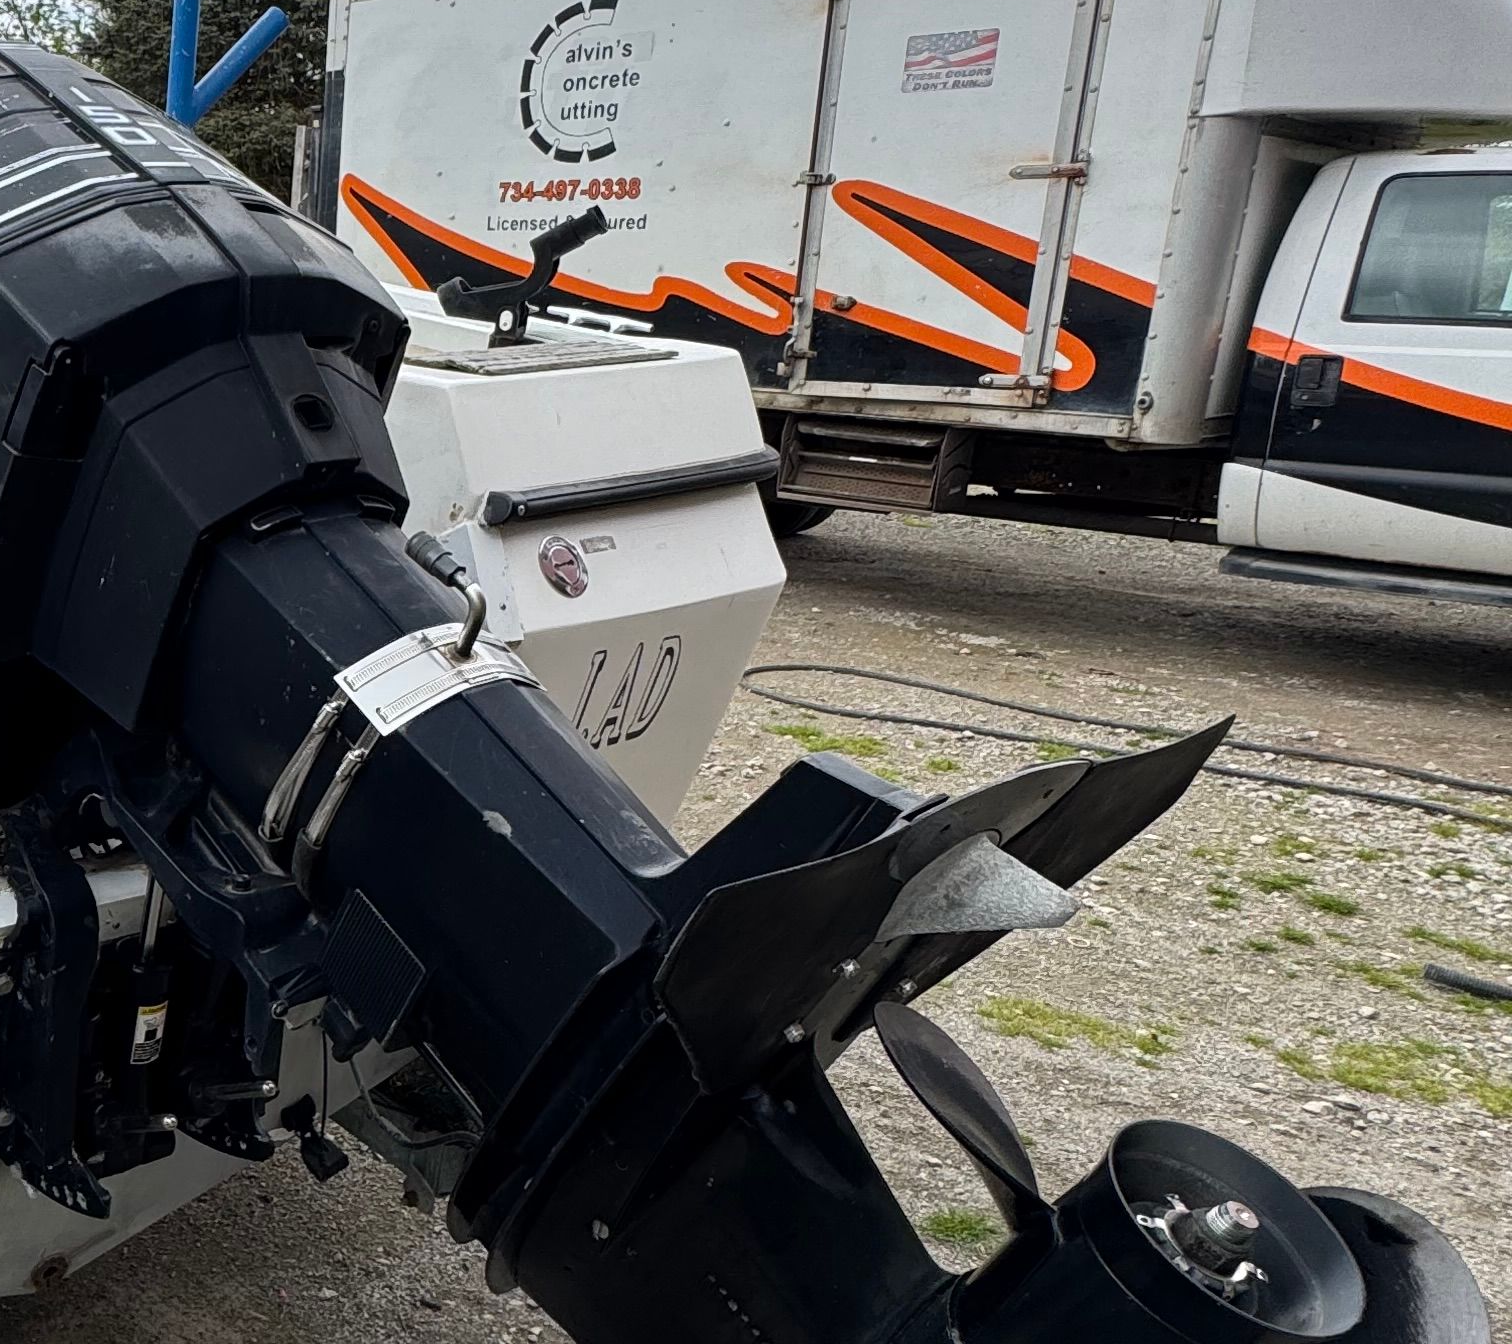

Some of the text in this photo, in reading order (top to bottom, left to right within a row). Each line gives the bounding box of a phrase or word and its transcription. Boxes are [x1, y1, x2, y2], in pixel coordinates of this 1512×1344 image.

[565, 39, 633, 64] alvin's
[563, 69, 640, 93] oncrete
[945, 68, 992, 79] COLORS
[560, 99, 619, 122] utting
[499, 177, 641, 202] 734-497-0338
[487, 215, 558, 231] Licensed
